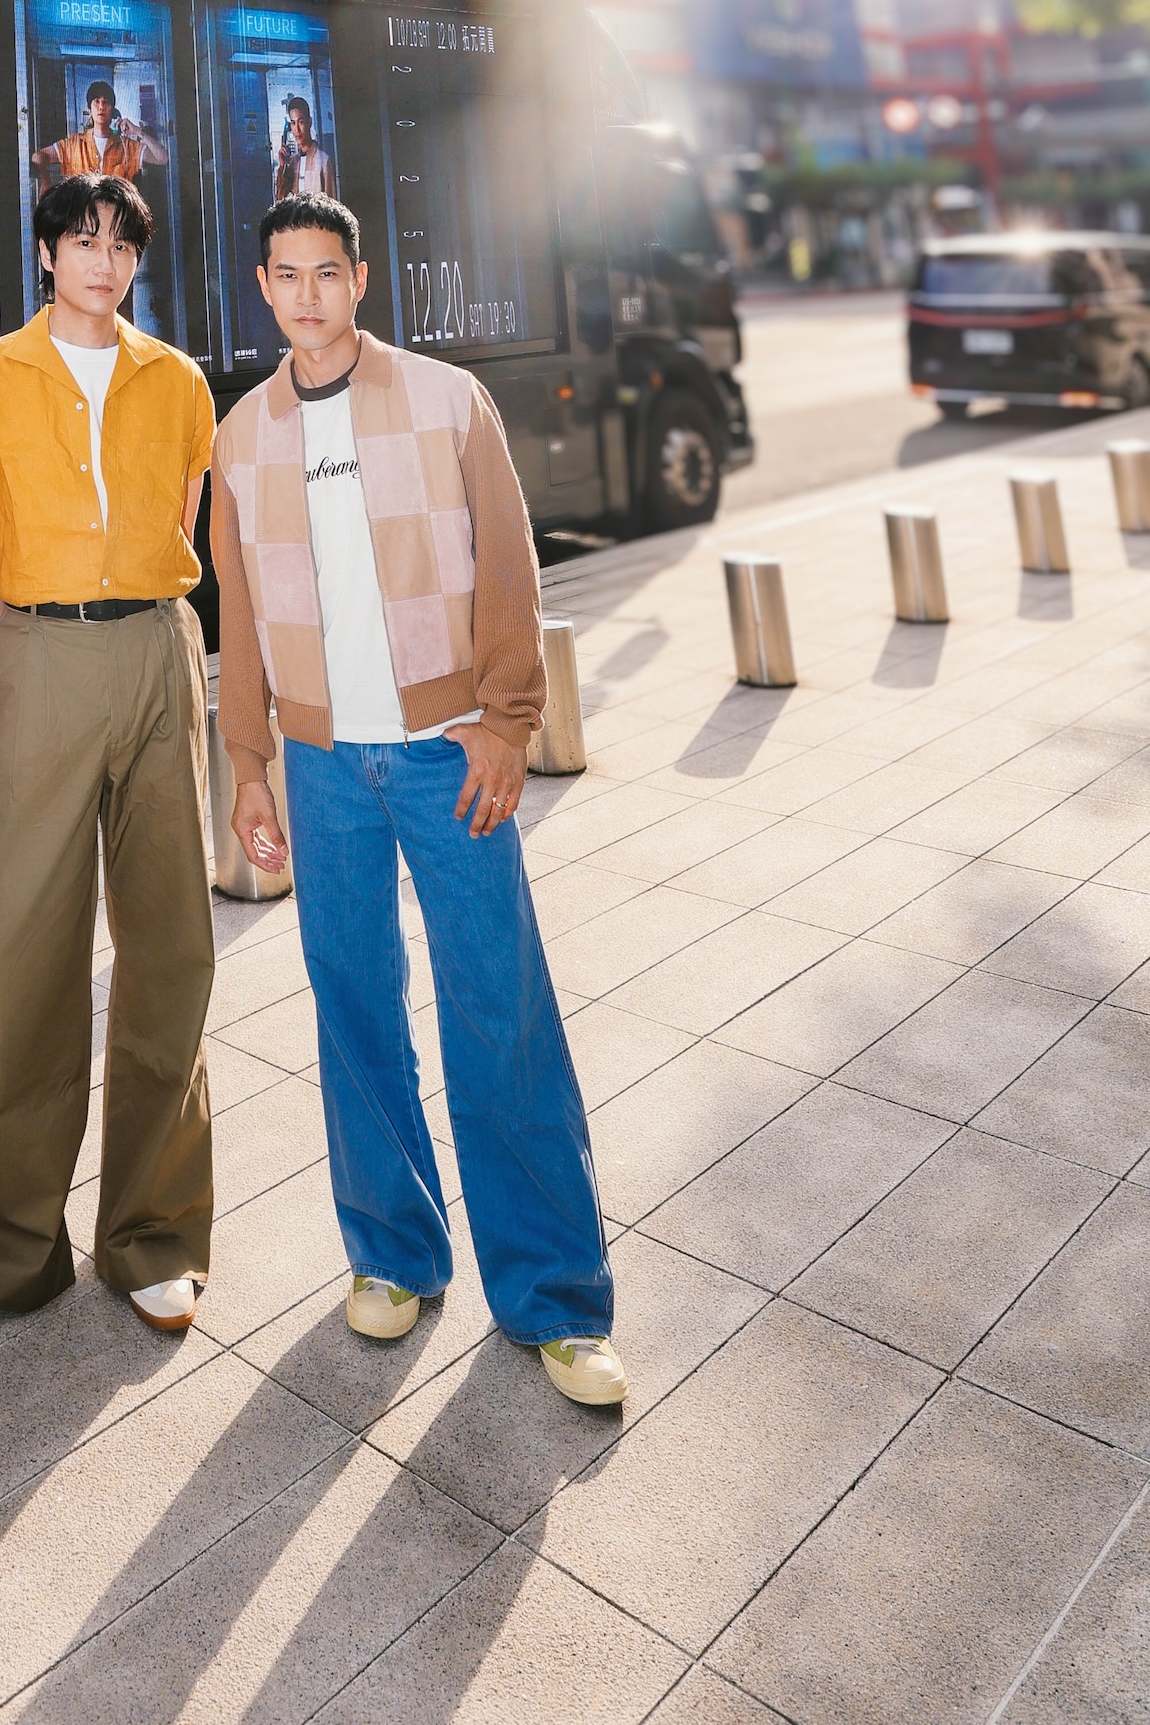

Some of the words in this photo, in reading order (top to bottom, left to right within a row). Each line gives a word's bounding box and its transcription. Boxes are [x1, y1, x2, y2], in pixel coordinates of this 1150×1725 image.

[59, 1, 133, 27] PRESENT
[246, 14, 298, 37] FUTURE
[407, 260, 465, 343] 12.20
[469, 303, 484, 338] SAT
